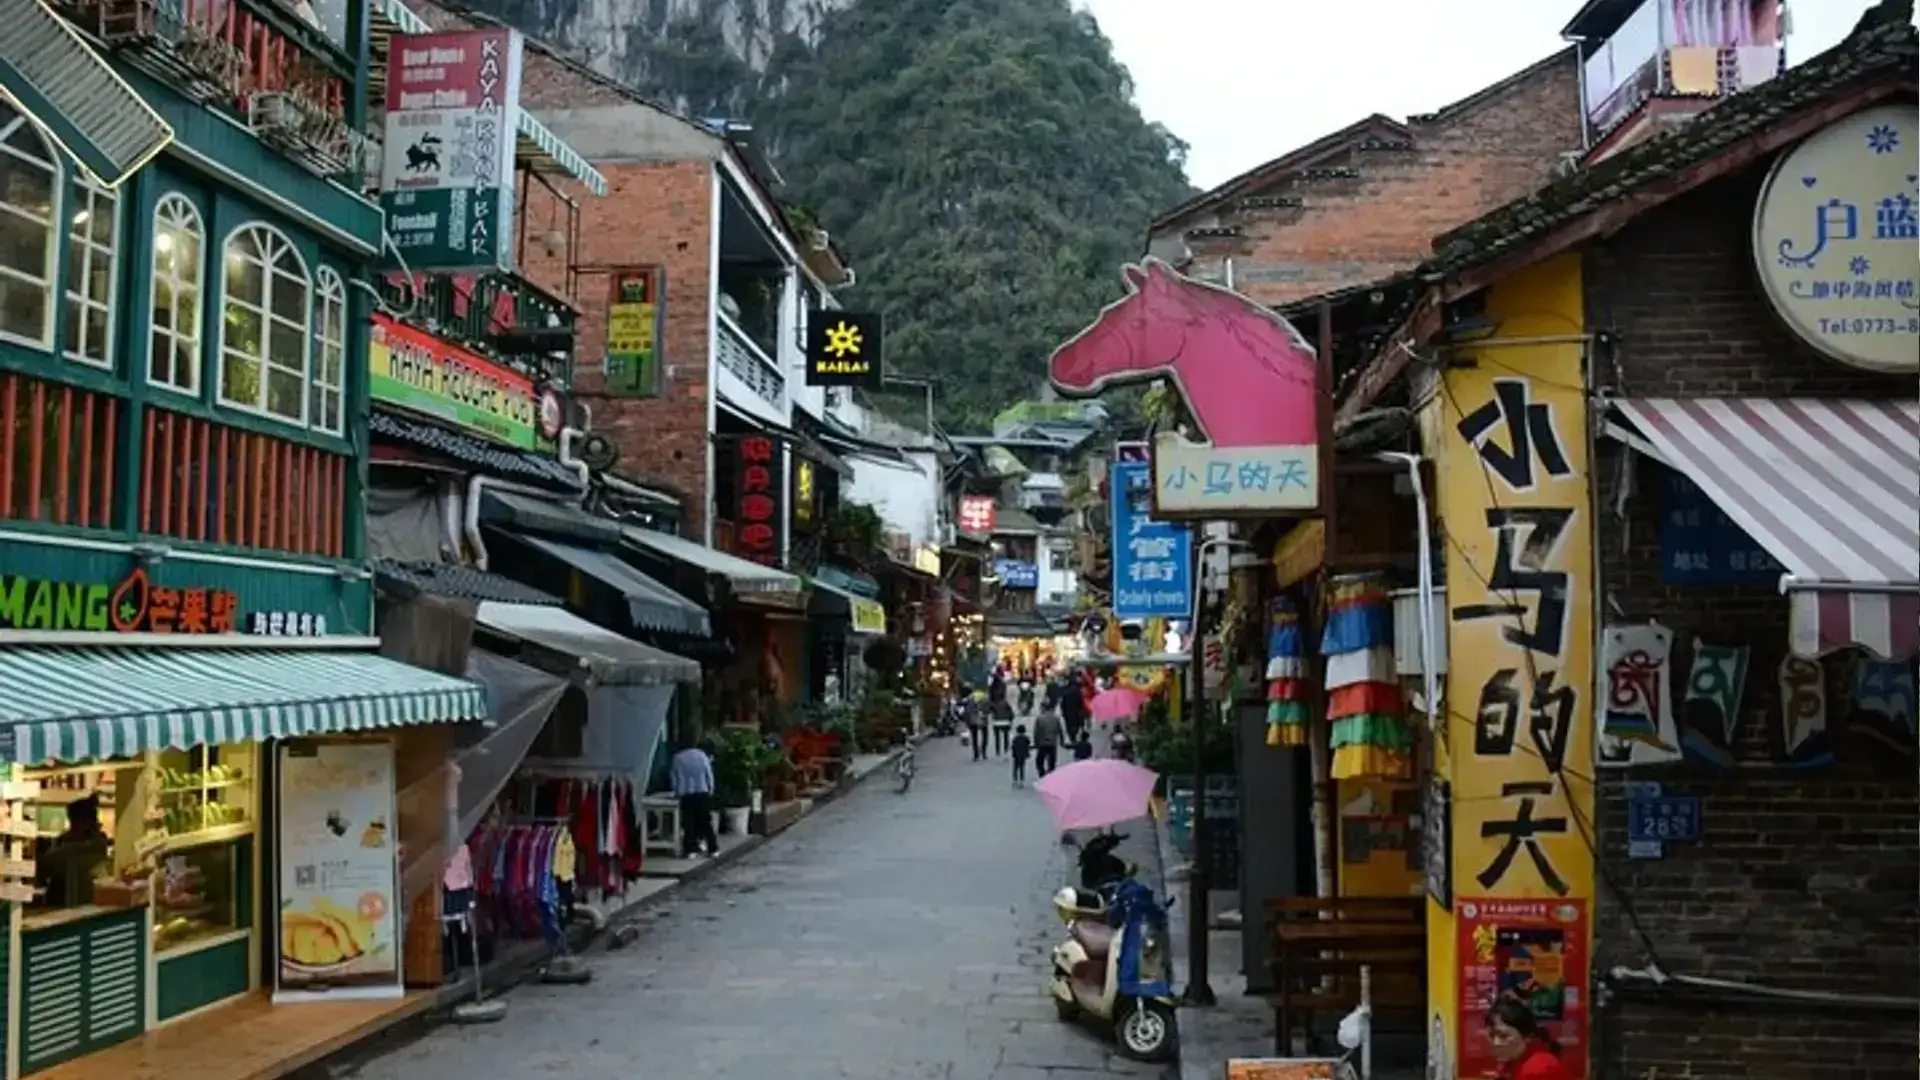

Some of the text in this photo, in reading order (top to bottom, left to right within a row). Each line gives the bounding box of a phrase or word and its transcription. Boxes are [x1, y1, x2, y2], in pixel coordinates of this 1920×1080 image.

[478, 39, 500, 116] KAYA
[1163, 458, 1309, 496] 小马的天
[1452, 376, 1578, 897] 小马的天
